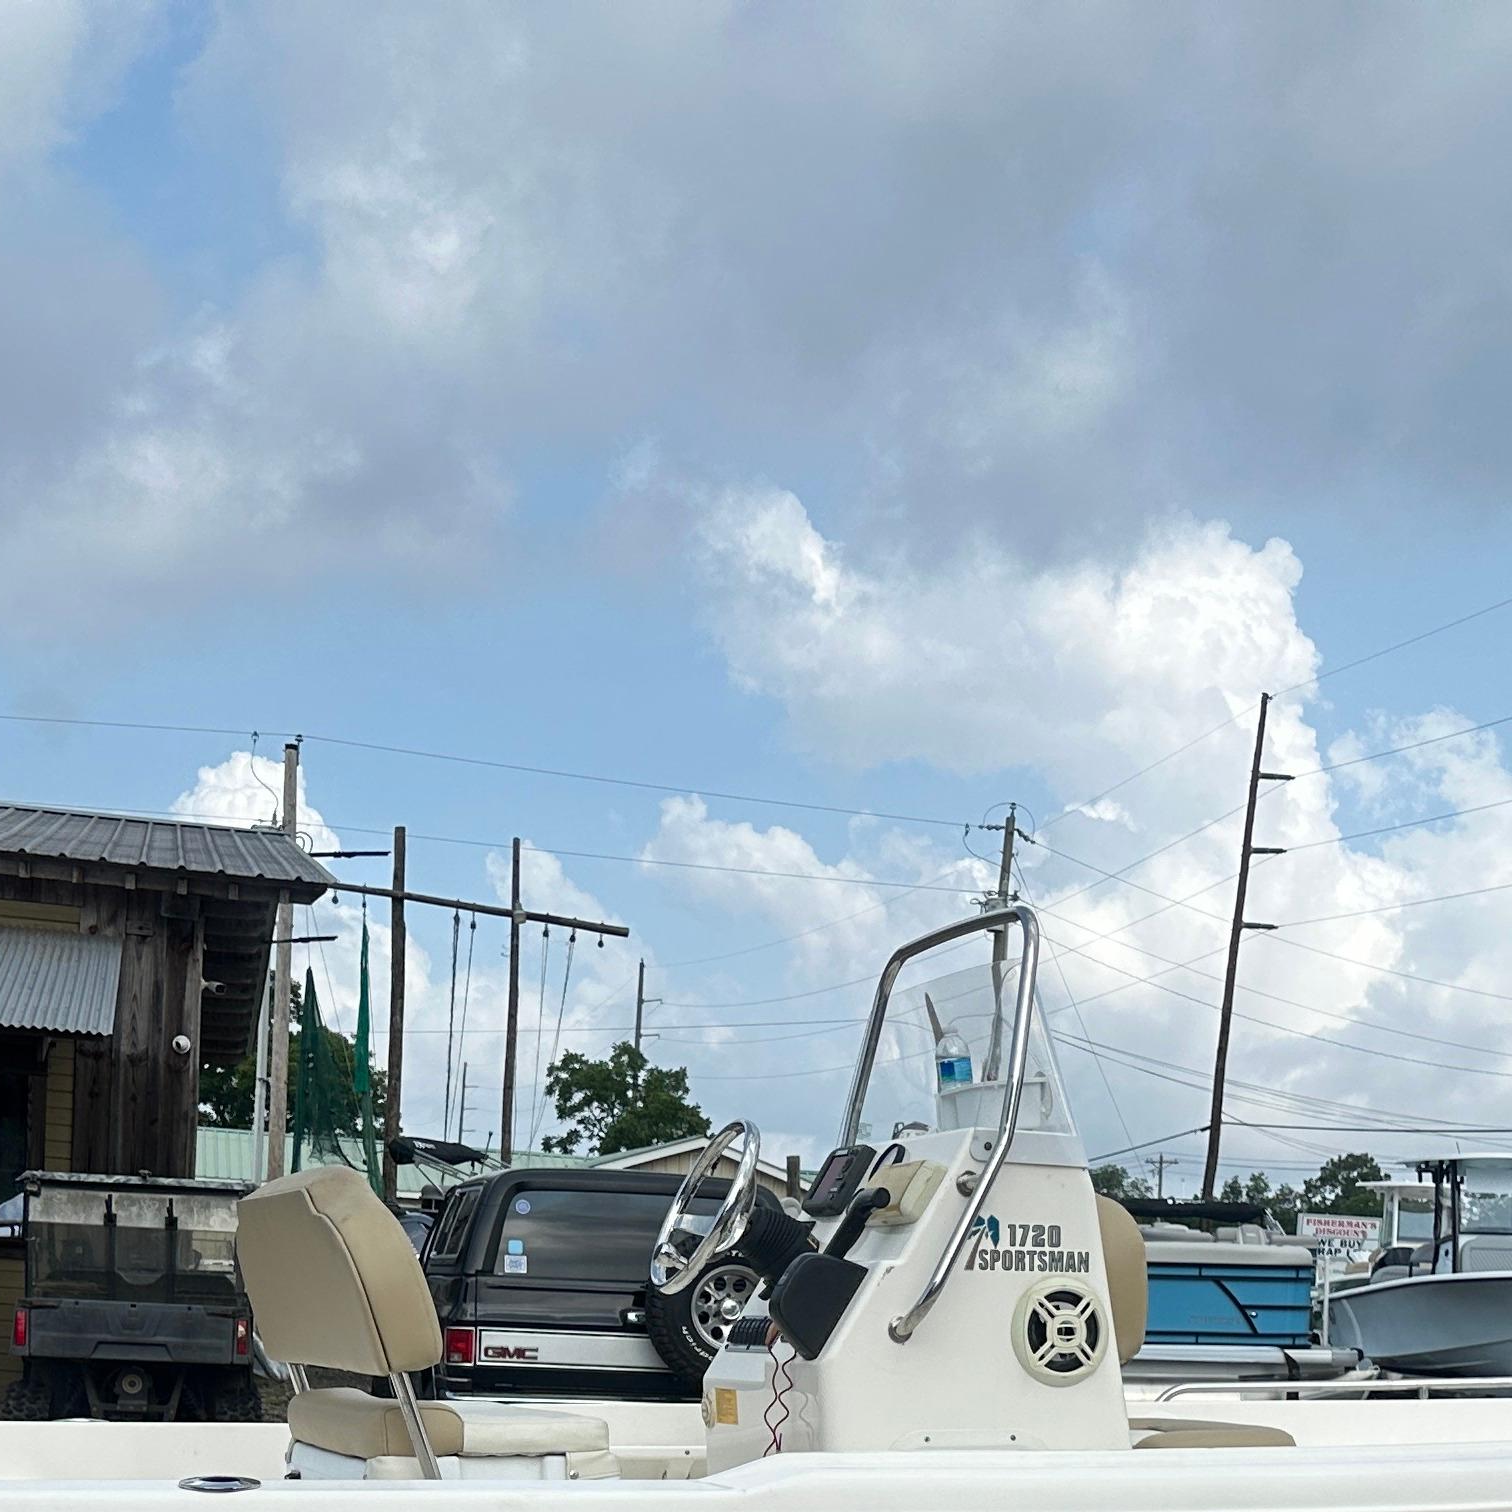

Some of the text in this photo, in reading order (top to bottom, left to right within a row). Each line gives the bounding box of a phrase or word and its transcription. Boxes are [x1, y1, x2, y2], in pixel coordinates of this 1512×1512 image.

[1305, 1218, 1378, 1230] FISHERMAN'S
[1007, 1224, 1061, 1248] 1720
[1340, 1240, 1362, 1249] BUY
[977, 1249, 1090, 1273] SPORTSMAN
[484, 1346, 538, 1360] GMC
